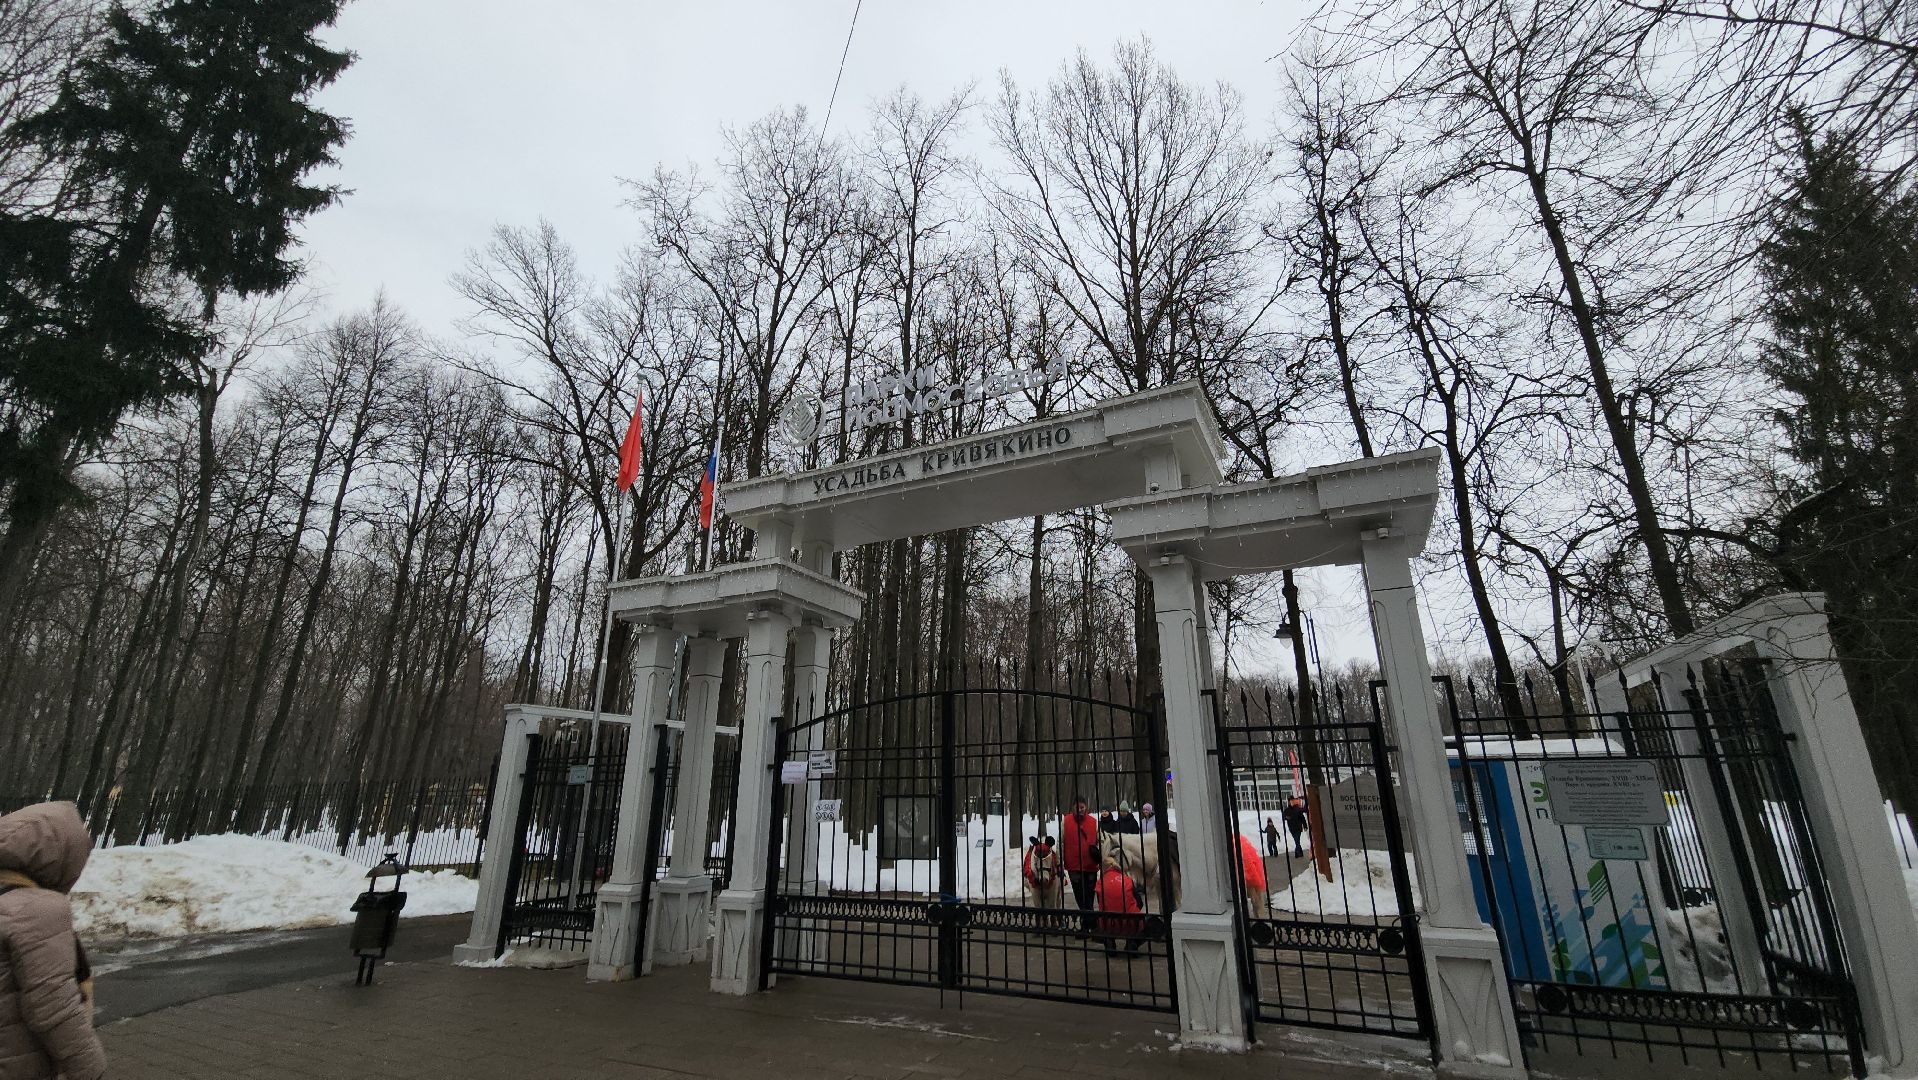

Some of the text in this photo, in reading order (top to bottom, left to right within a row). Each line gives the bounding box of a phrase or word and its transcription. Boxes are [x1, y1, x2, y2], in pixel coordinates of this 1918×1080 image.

[844, 365, 936, 407] ПАРКИ
[844, 356, 1068, 432] ПОДМОСКОВЬЯ
[813, 427, 1071, 495] УСАДЬБА КРИВЯКИНО
